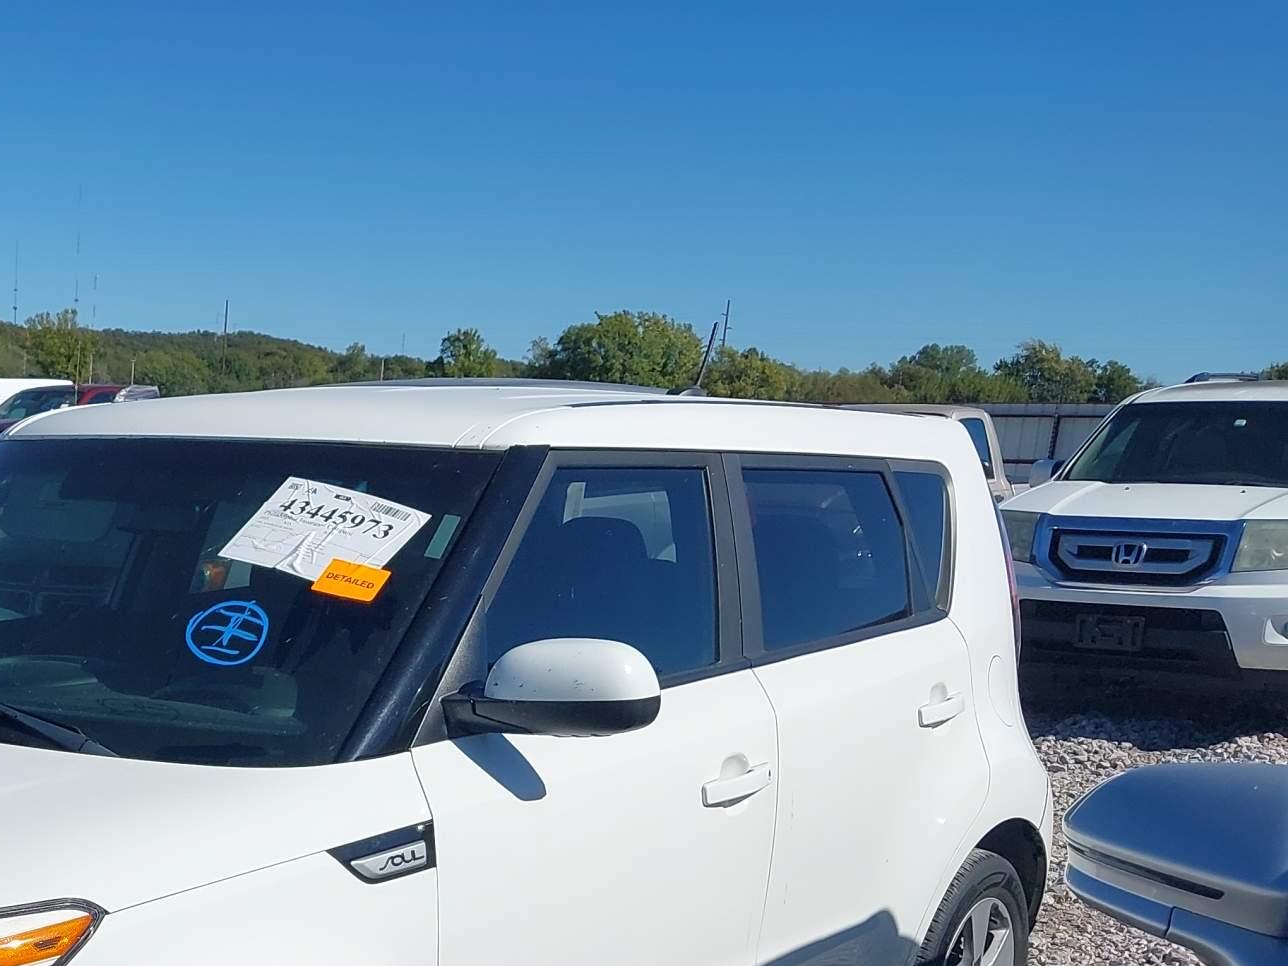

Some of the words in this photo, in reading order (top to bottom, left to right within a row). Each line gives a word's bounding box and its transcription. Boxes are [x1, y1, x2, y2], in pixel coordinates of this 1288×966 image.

[280, 498, 394, 539] 43445973
[326, 572, 375, 589] DETAILED
[379, 850, 425, 871] SOUL
